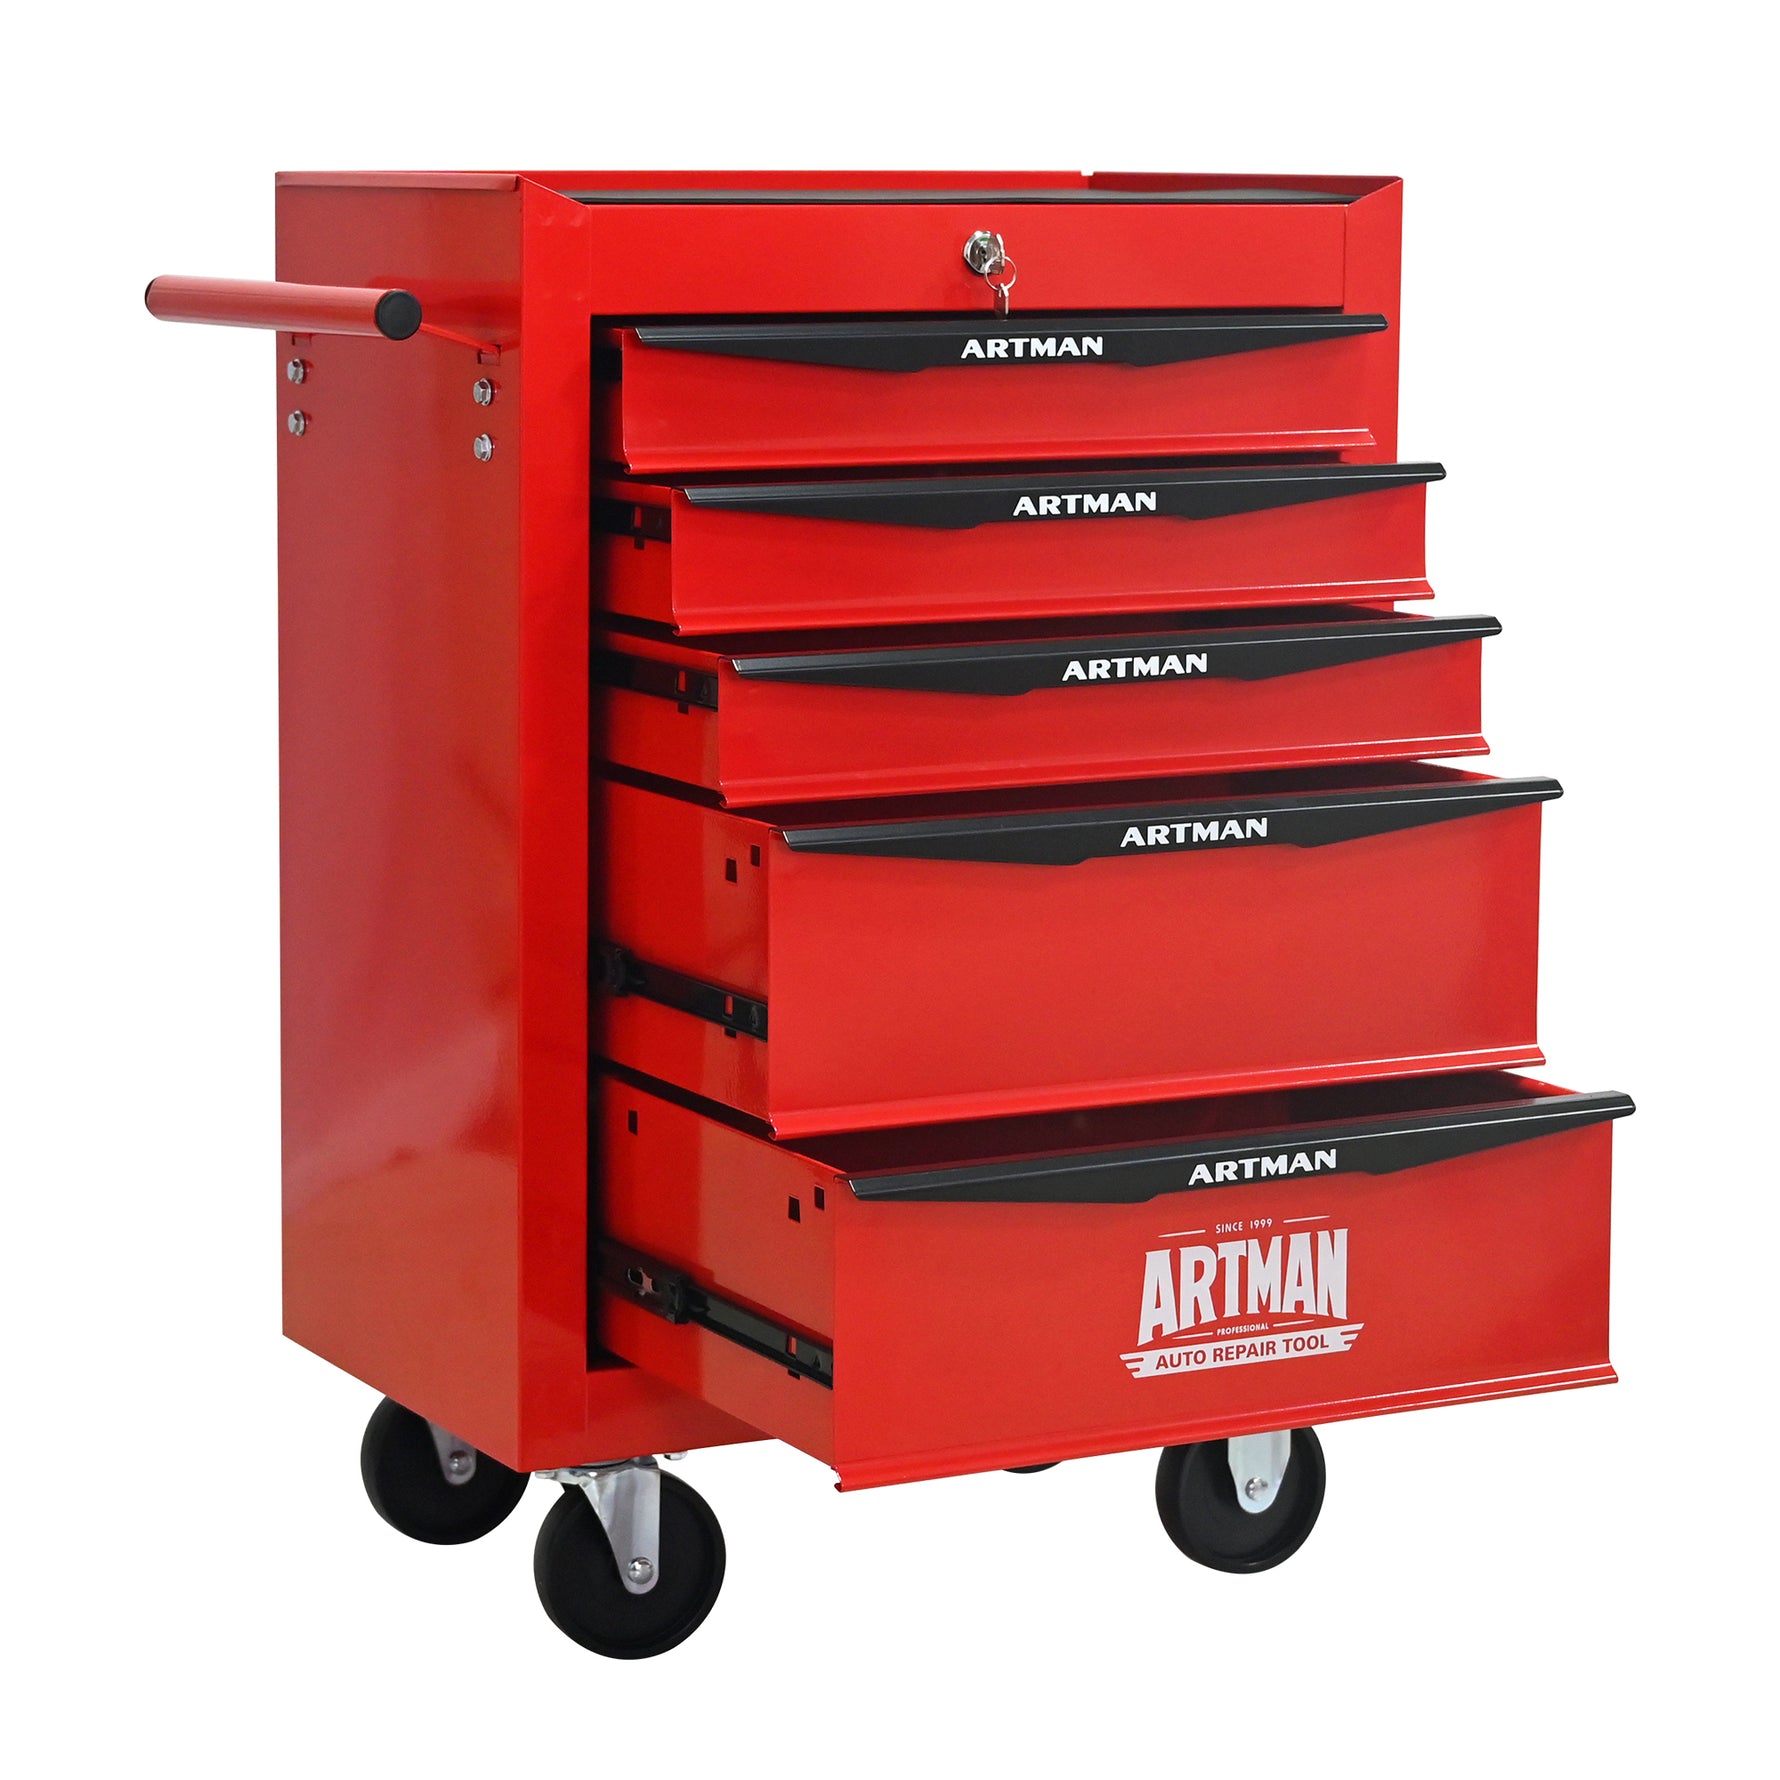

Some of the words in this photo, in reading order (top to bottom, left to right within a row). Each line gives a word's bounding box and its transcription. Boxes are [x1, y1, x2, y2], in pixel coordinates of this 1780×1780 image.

[961, 336, 1103, 359] ARTMAN
[1013, 491, 1157, 516] ARTMAN
[1062, 653, 1207, 681] ARTMAN
[1120, 817, 1267, 847] ARTMAN
[1188, 1149, 1336, 1185] ARTMAN
[1215, 1221, 1243, 1234] SINCE
[1250, 1218, 1273, 1229] 1999
[1137, 1228, 1349, 1346] ARTMAN
[1216, 1322, 1269, 1336] PROFESSIONAL
[1155, 1350, 1207, 1370] AUTO
[1213, 1340, 1277, 1363] REPAIR
[1282, 1334, 1329, 1353] TOOL
